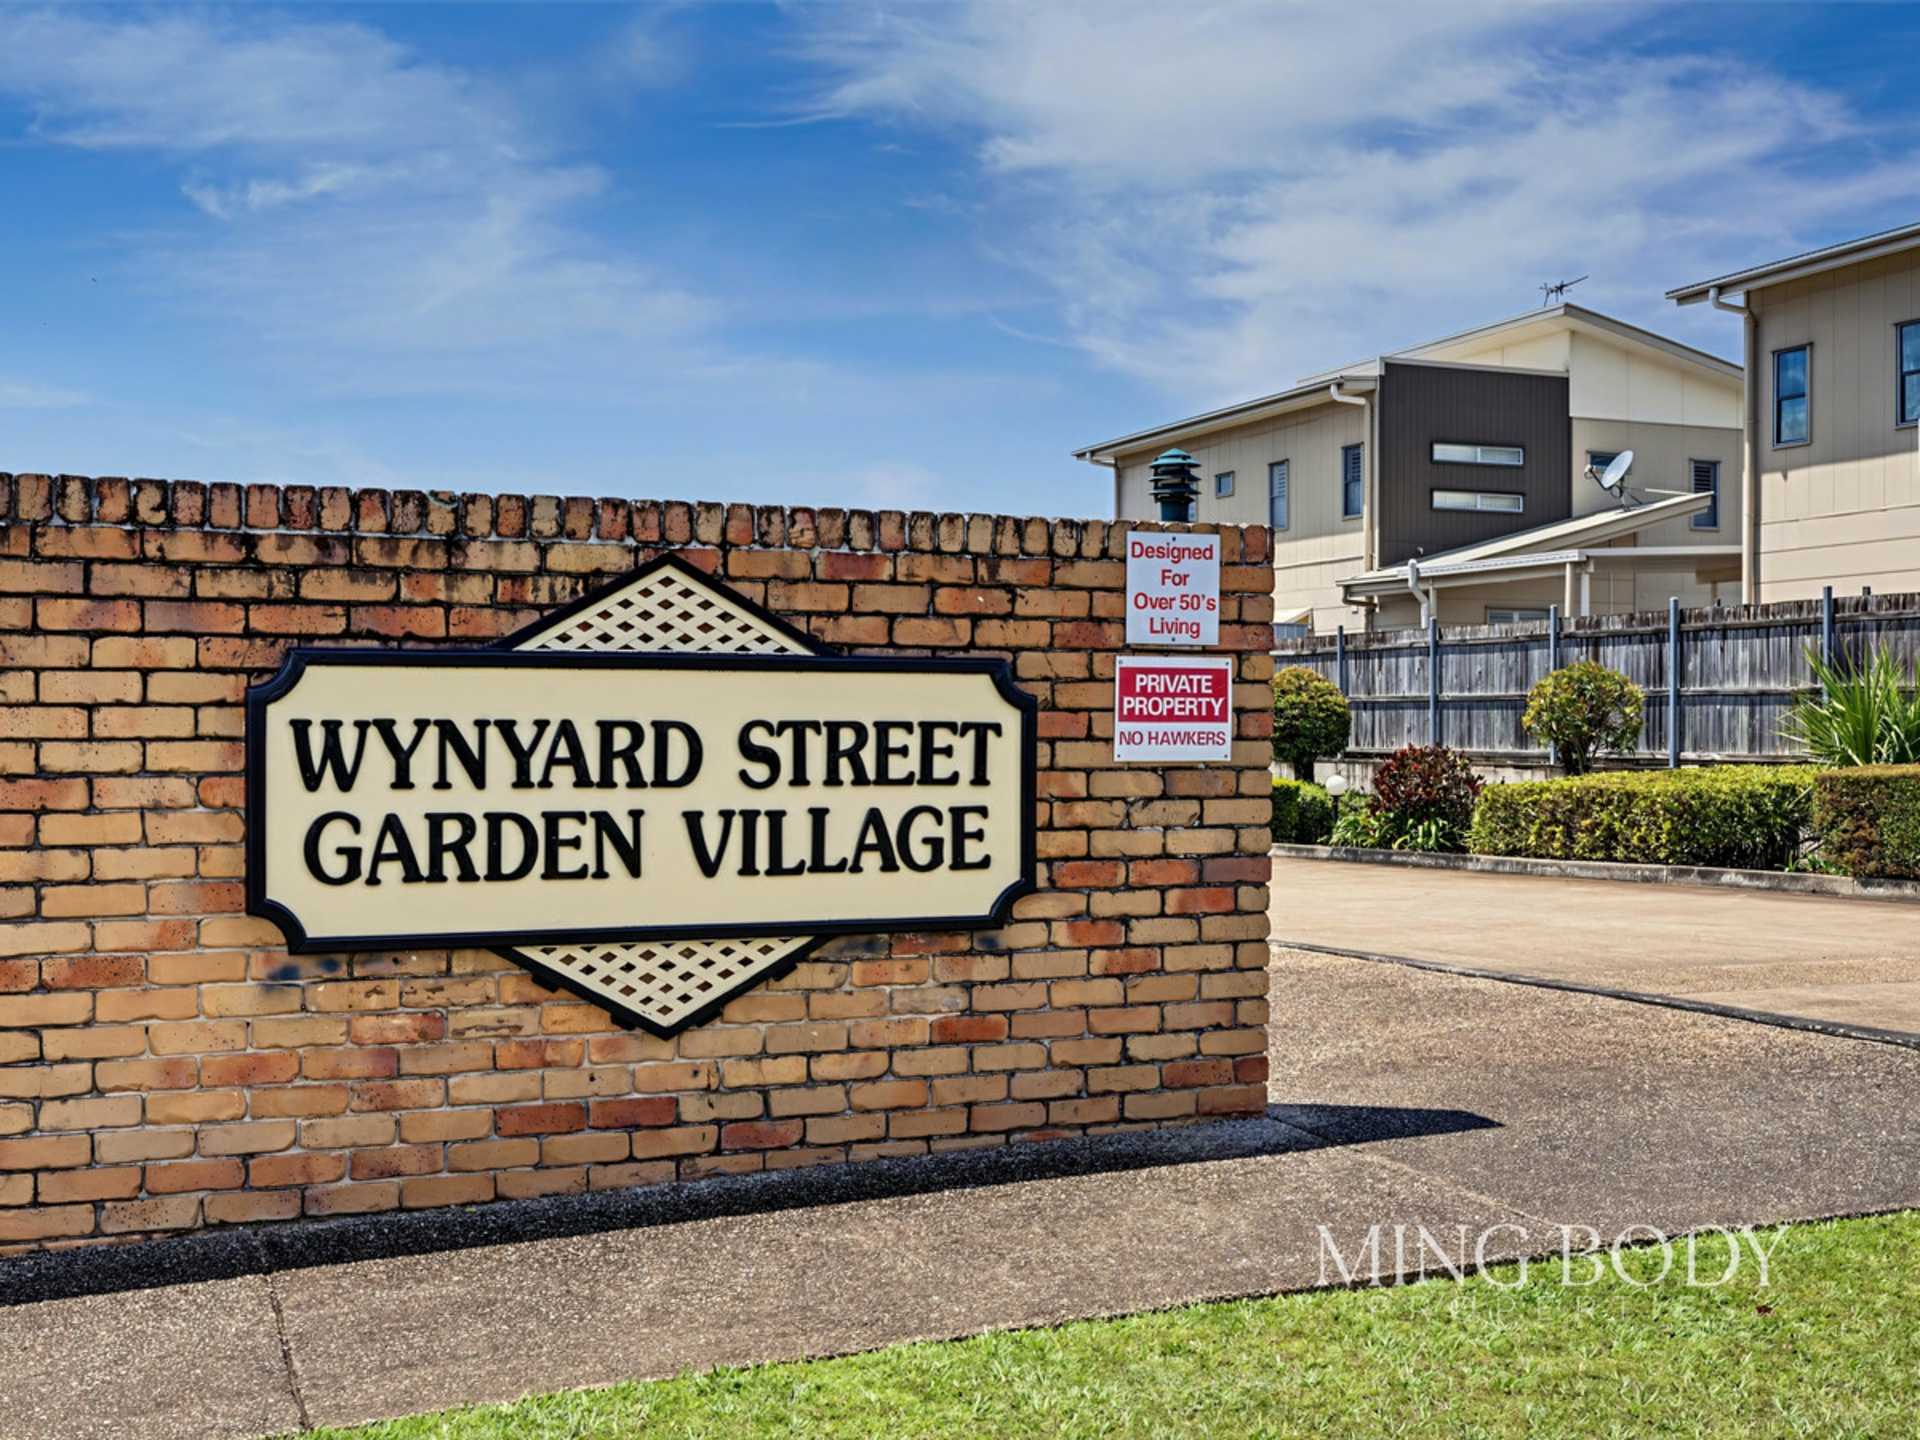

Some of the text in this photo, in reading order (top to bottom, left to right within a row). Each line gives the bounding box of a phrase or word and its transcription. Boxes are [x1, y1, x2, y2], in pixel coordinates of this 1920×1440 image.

[1131, 541, 1214, 564] Designed
[1161, 569, 1190, 586] For
[1133, 592, 1217, 611] Over 50's
[1149, 617, 1201, 639] Living
[1135, 674, 1213, 694] PRIVATE
[1122, 696, 1225, 716] PROPERTY
[1118, 730, 1226, 746] NO HAWKERS
[289, 718, 1003, 793] WYNYARD STREET
[302, 805, 991, 887] GARDEN VILLAGE
